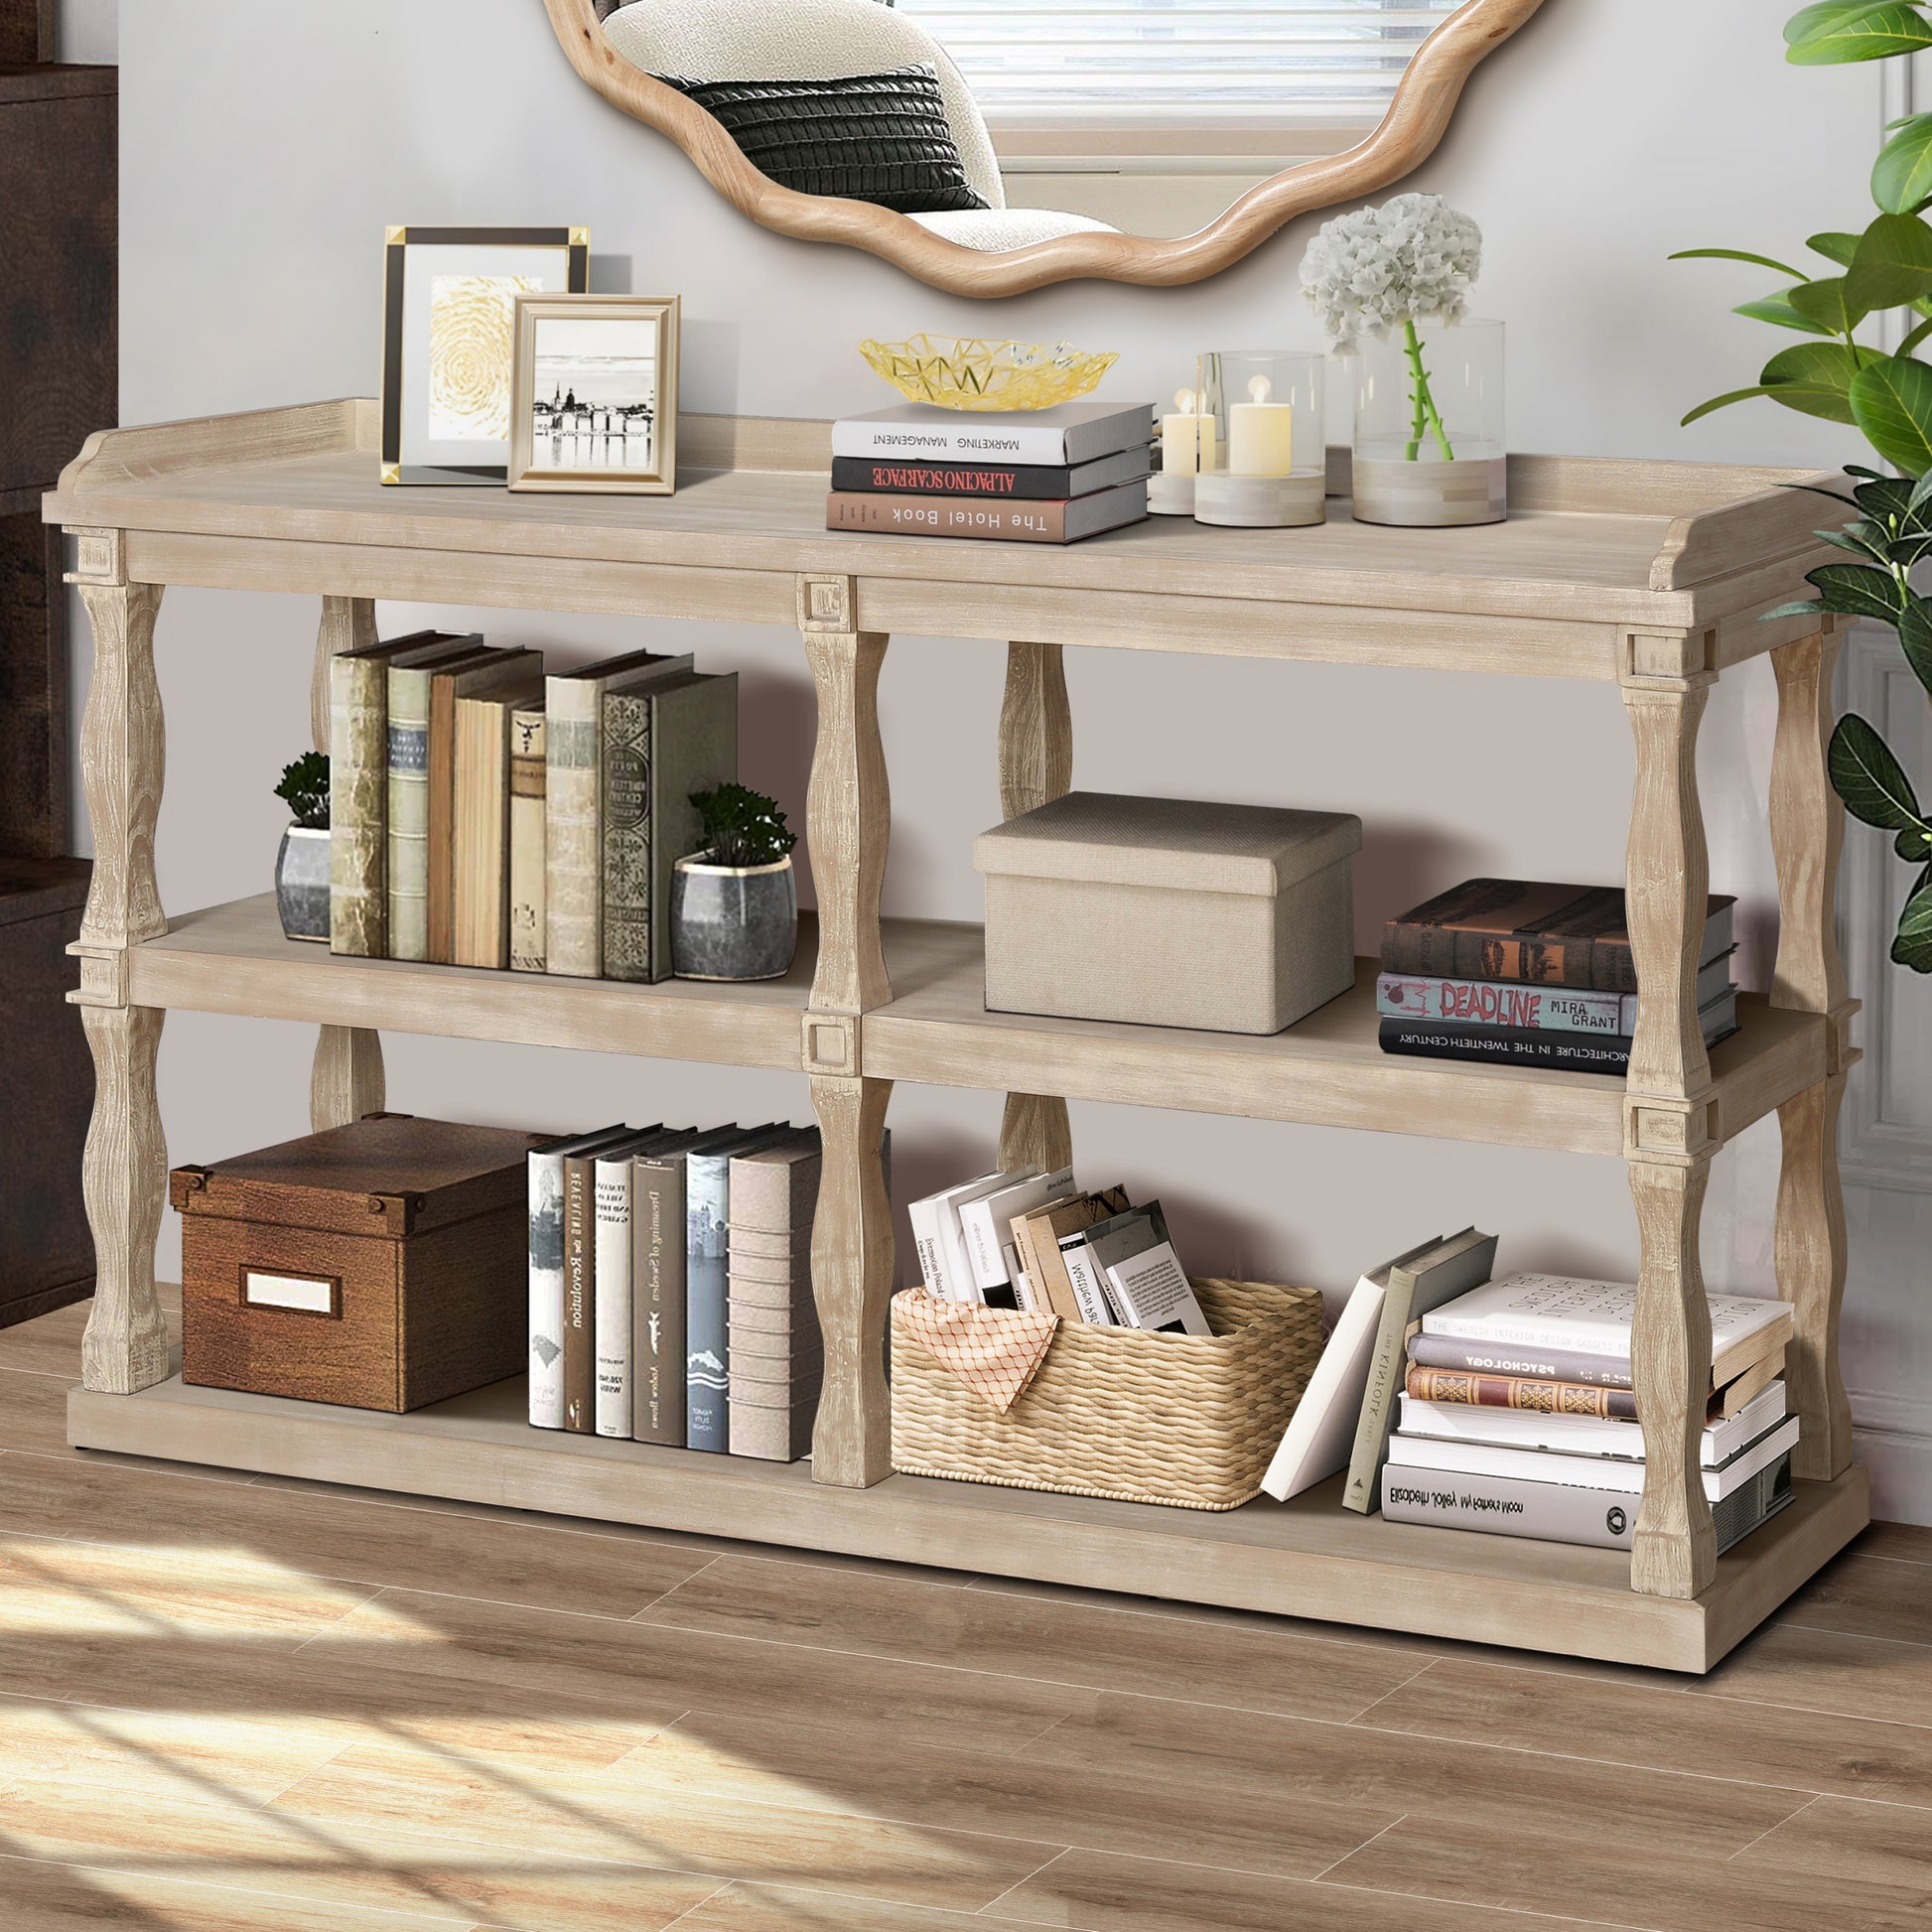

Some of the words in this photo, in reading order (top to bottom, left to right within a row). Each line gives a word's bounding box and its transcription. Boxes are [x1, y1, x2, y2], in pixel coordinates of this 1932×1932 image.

[873, 434, 947, 447] MANAGEMENT
[957, 438, 1020, 450] MARKETING
[892, 508, 938, 524] Book
[949, 511, 1000, 528] Hotel
[1011, 514, 1046, 531] The
[1440, 982, 1541, 1030] DEADLINE
[1550, 1000, 1587, 1015] MIRA
[1572, 1014, 1617, 1030] GRANT
[1400, 1034, 1449, 1046] CENTURY
[1449, 1037, 1509, 1051] TWENTIETH
[1514, 1042, 1534, 1053] THE
[1539, 1044, 1551, 1054] IN
[1502, 1276, 1544, 1289] THE
[1509, 1280, 1581, 1310] SWEDISH
[1537, 1284, 1618, 1317] INTERIOR
[1433, 1320, 1449, 1331] THE
[1452, 1323, 1489, 1335] SWEDISH
[1494, 1327, 1535, 1341] INTERIOR
[1540, 1332, 1572, 1346] DESIGN
[1576, 1337, 1613, 1350] GADGETS
